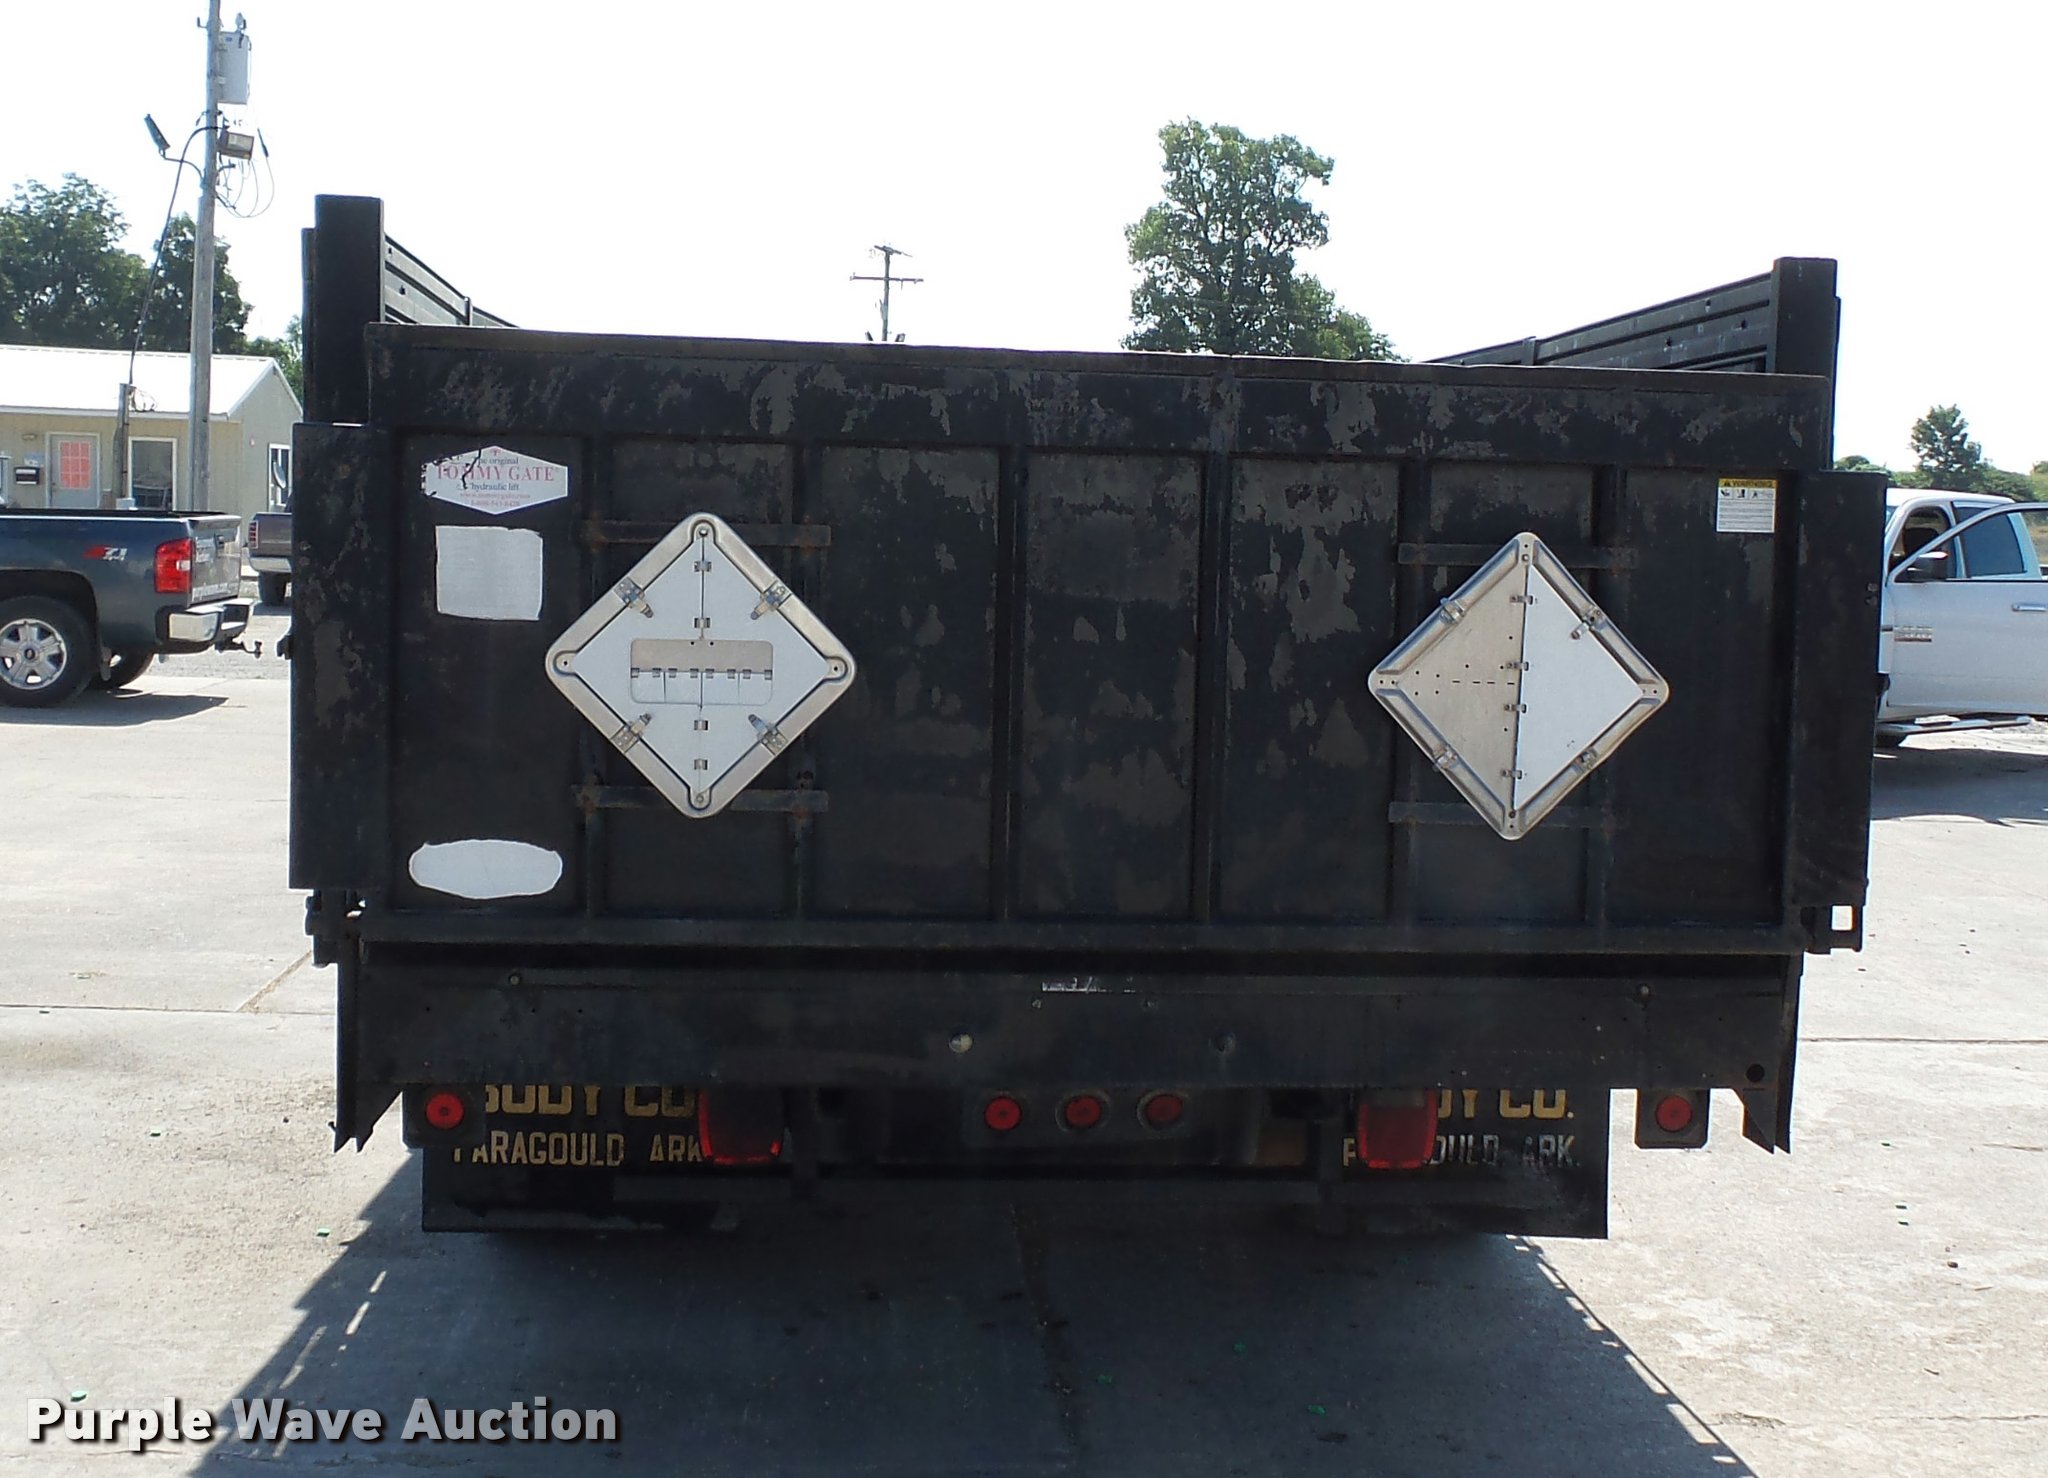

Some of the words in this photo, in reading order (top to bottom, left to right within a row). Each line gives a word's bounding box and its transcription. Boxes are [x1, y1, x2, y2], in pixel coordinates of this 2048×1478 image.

[489, 457, 519, 466] original
[437, 466, 502, 481] TOMMY
[508, 466, 555, 482] GATE
[470, 483, 507, 492] hydraulic
[508, 483, 520, 491] lift
